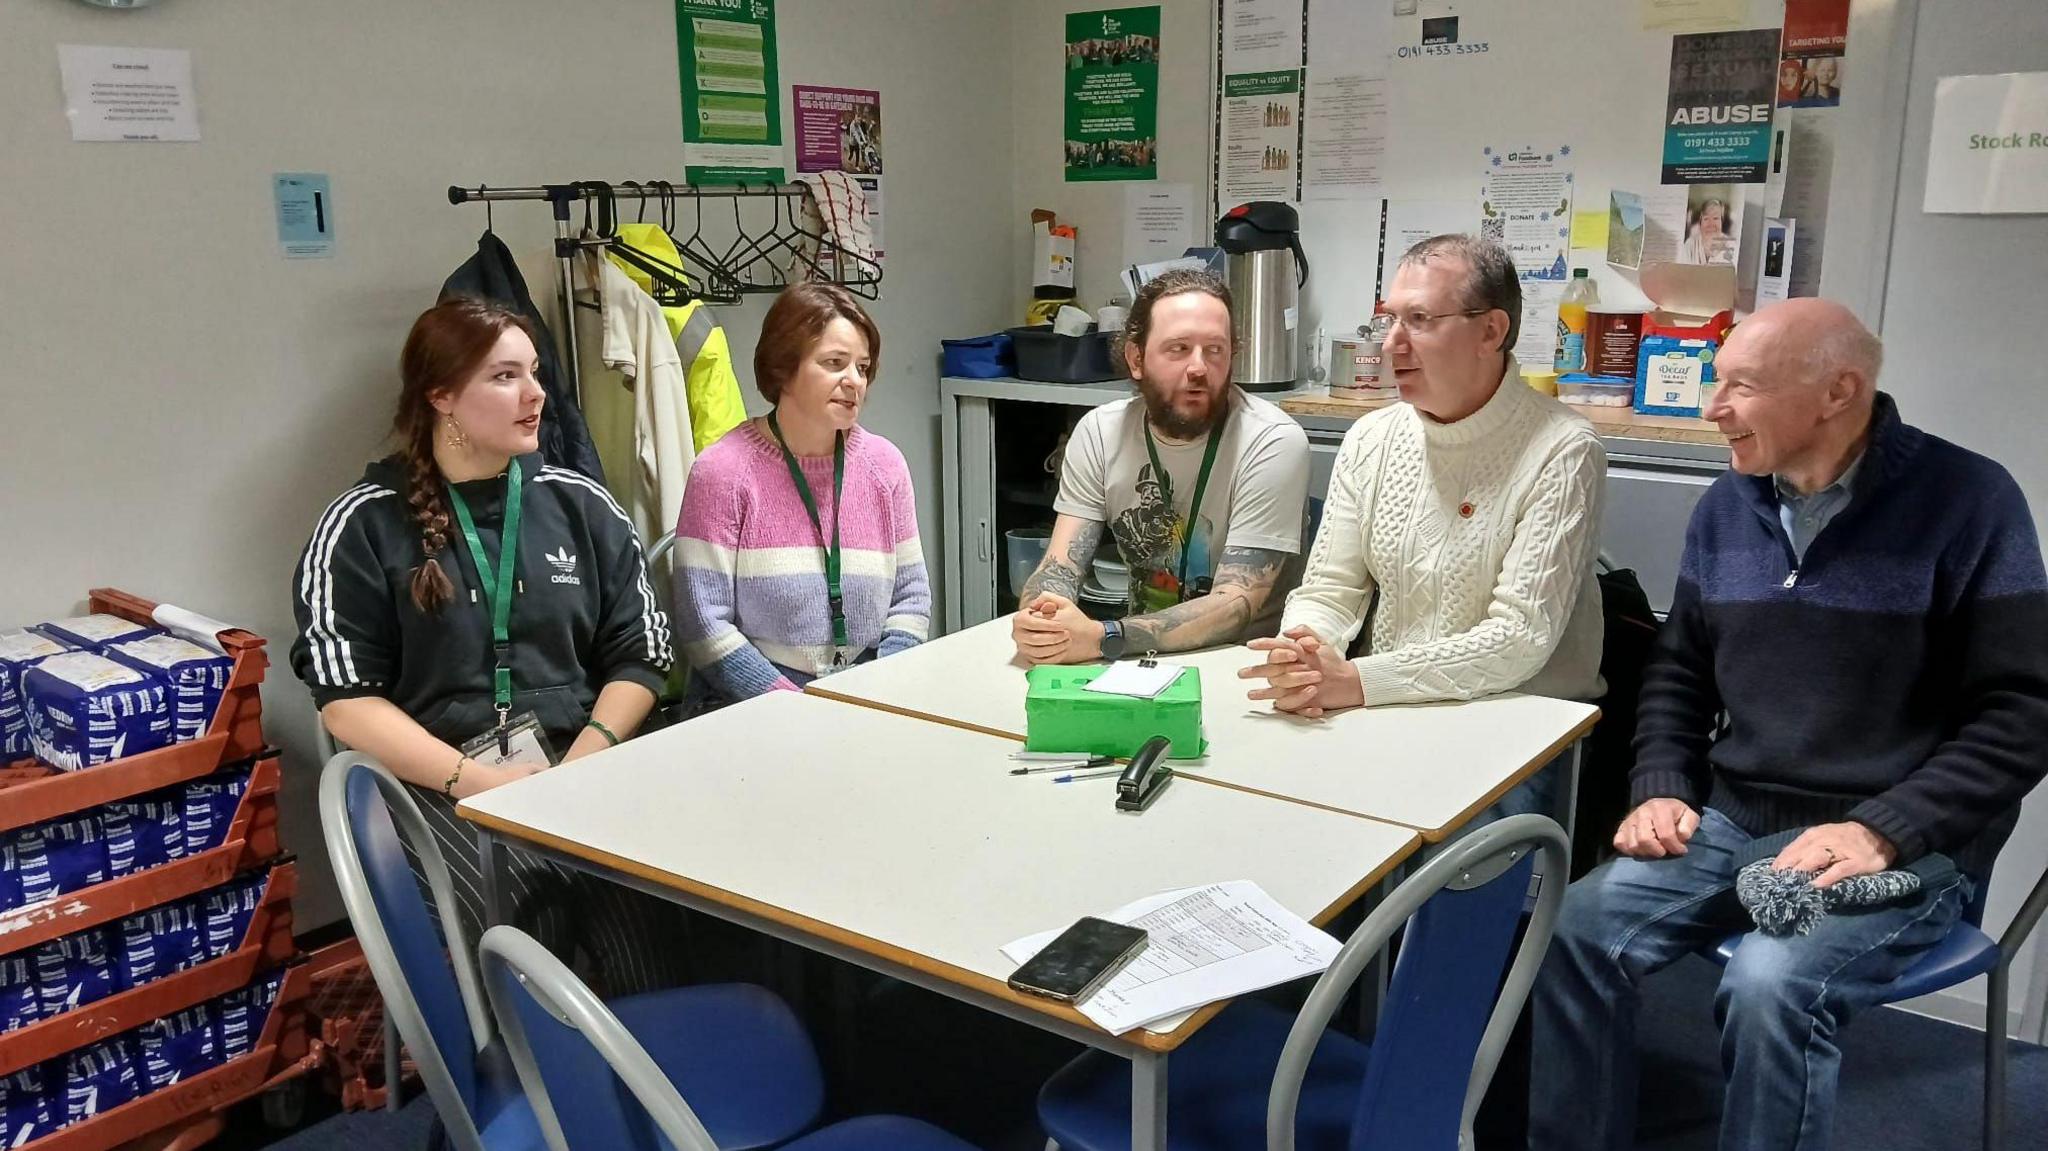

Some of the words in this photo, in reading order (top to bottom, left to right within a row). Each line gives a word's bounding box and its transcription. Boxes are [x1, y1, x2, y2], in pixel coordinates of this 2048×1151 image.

[1424, 37, 1448, 45] ABUSE
[1790, 37, 1830, 47] TARGETING
[1398, 46, 1422, 58] 0191
[1426, 45, 1451, 56] 433
[1456, 43, 1489, 55] 3333
[1676, 60, 1772, 78] SEXUAL
[1229, 79, 1258, 88] EQUALITY
[1268, 75, 1291, 84] EQUITY
[1671, 104, 1769, 125] ABUSE
[1684, 138, 1705, 147] 0191
[1708, 138, 1725, 147] 433
[1727, 137, 1751, 146] 3333
[1969, 132, 2023, 149] Stock
[1355, 356, 1381, 364] KENCO
[1659, 365, 1692, 375] Decaf
[551, 573, 580, 585] adidas
